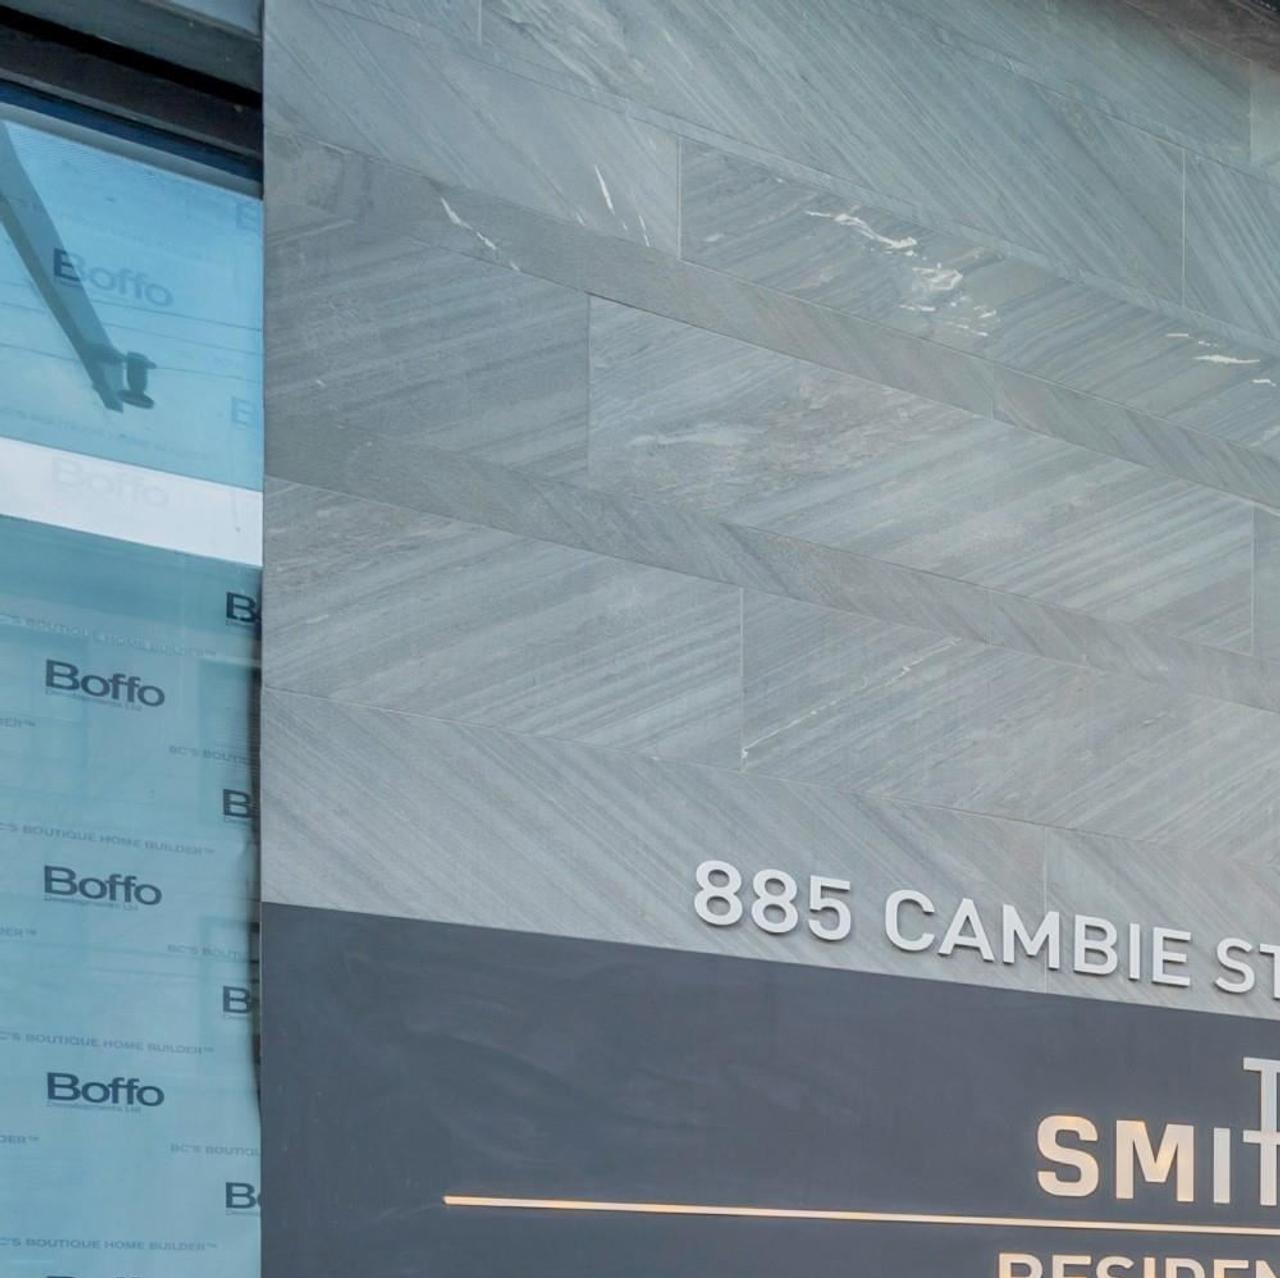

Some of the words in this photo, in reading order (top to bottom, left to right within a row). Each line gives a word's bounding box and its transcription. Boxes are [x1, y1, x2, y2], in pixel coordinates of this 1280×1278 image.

[53, 248, 173, 306] Boffo
[45, 659, 165, 707] Boffo
[44, 865, 162, 906] Boffo
[694, 860, 852, 941] 885
[883, 888, 1192, 987] CAMBIE
[47, 1072, 165, 1107] Boffo
